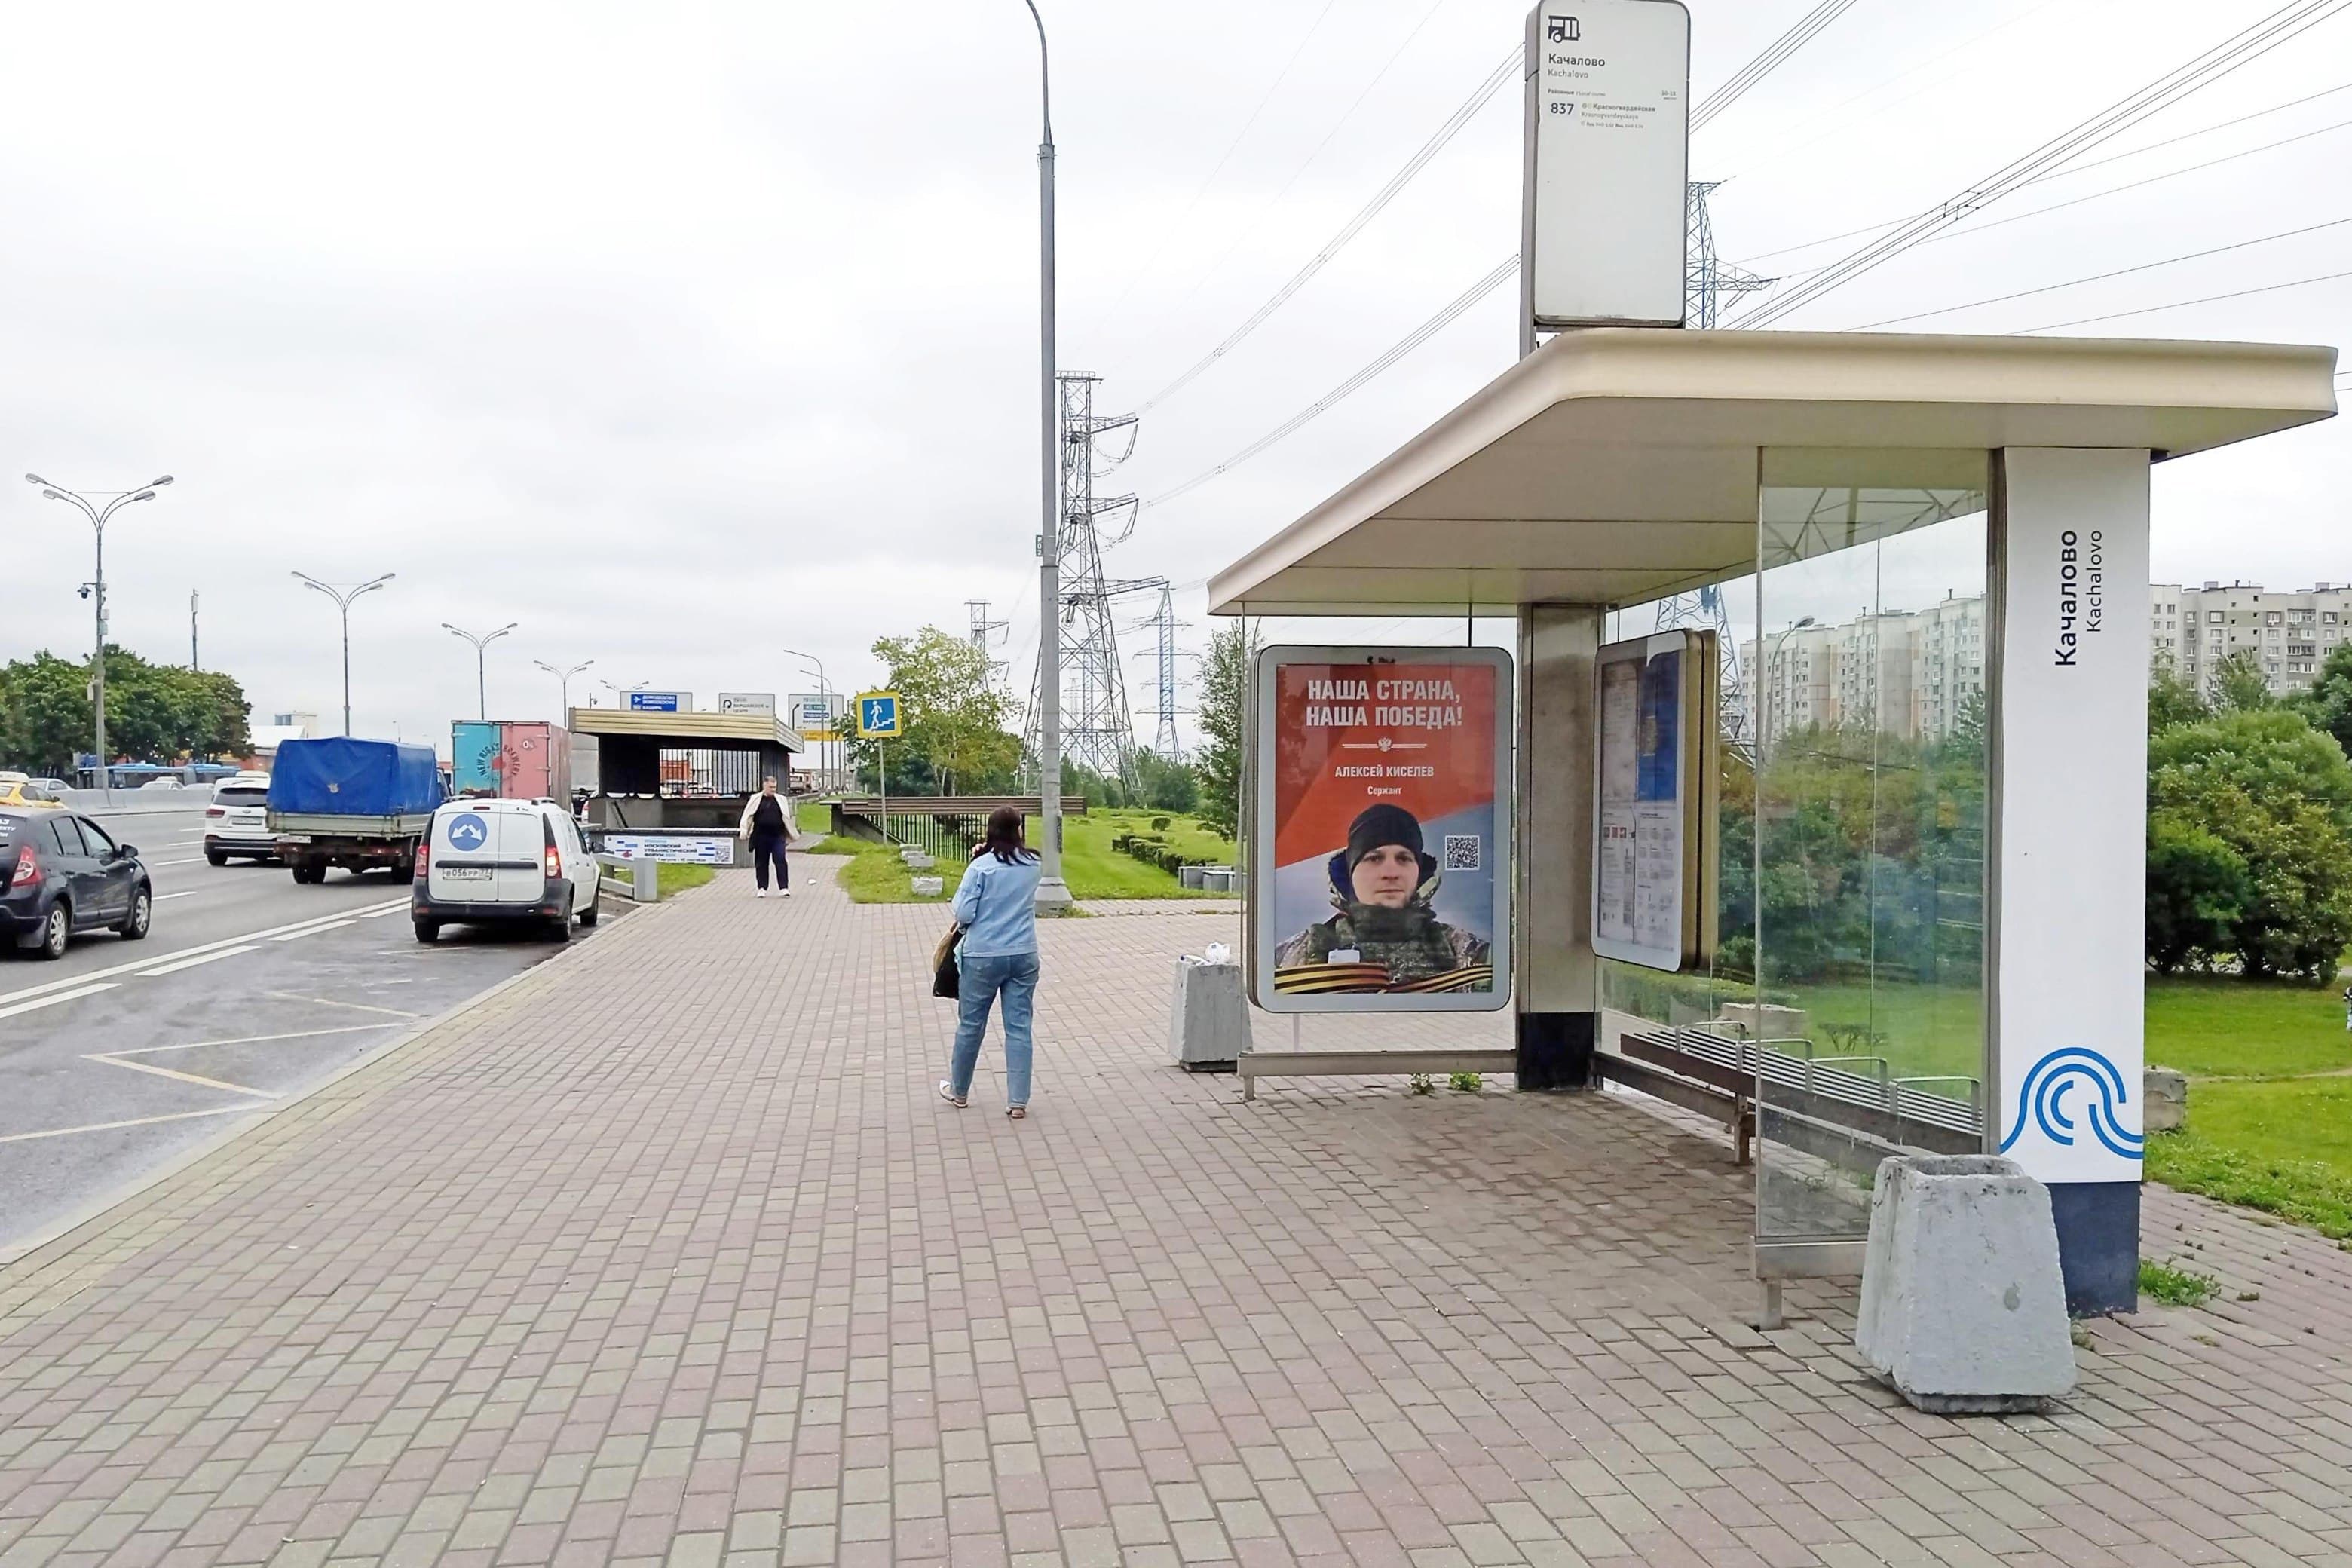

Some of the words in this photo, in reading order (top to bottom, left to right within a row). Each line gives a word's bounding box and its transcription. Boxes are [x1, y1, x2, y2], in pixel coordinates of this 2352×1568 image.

[1548, 53, 1606, 66] Качалово
[1548, 68, 1589, 78] Kachalovo
[1551, 103, 1574, 115] 837
[1593, 103, 1656, 112] Красногвардейская
[2085, 530, 2102, 632] Kachalovo
[2055, 530, 2078, 666] Качалово
[1308, 680, 1370, 700] НАША
[1377, 680, 1461, 703] СТРАНА,
[1306, 706, 1368, 726] НАША
[1375, 706, 1462, 730] ПОБЕДА!
[1335, 764, 1383, 777] АЛЕКСЕЙ
[1386, 766, 1434, 777] КИСЕЛЕВ
[1367, 786, 1402, 796] Сержант
